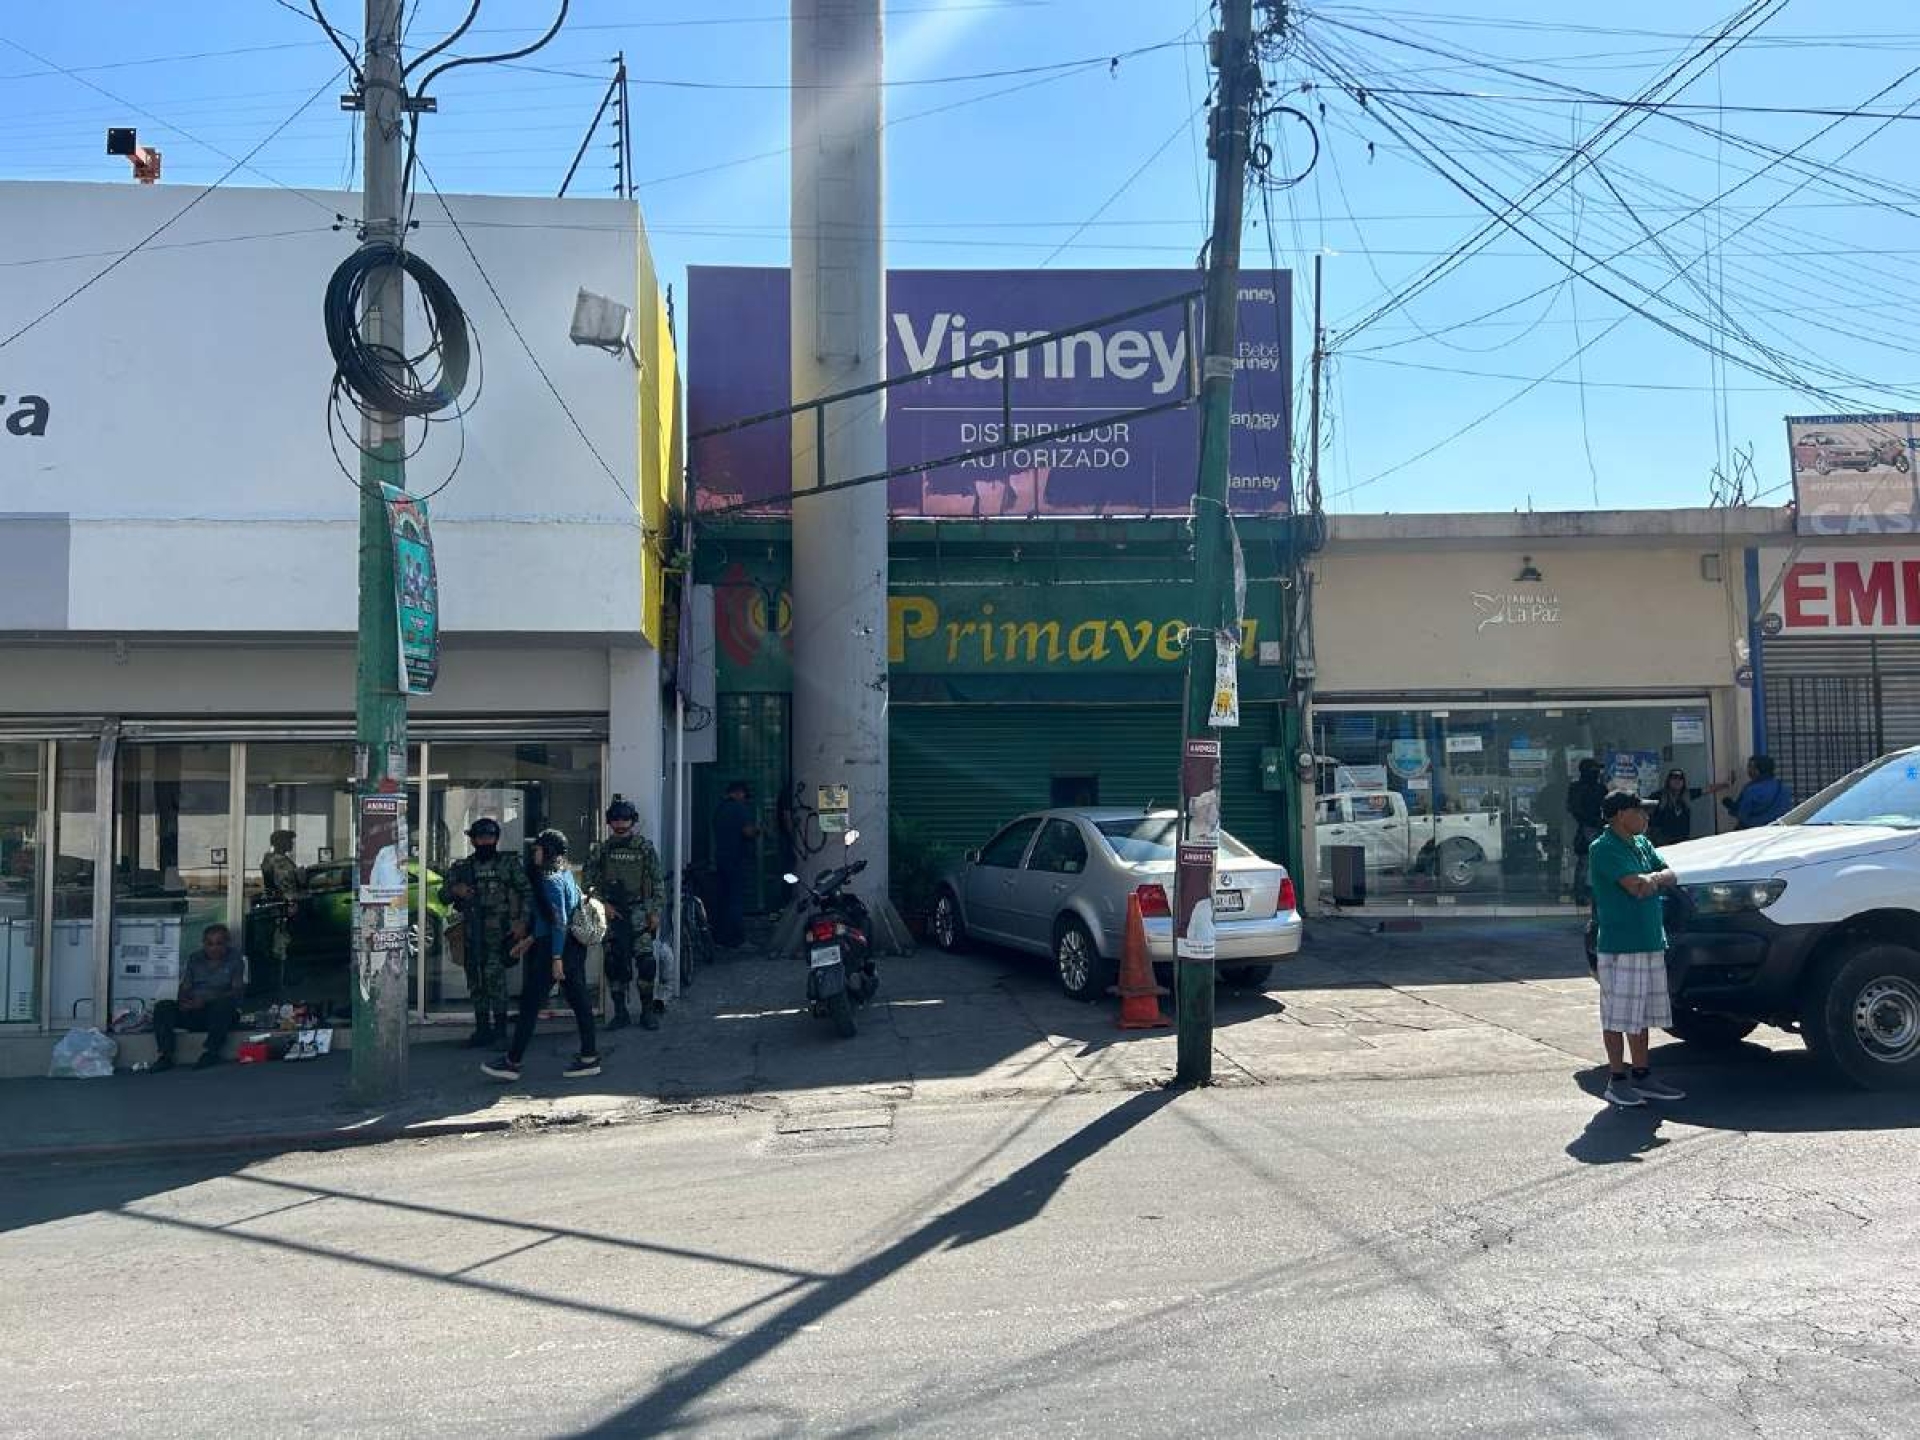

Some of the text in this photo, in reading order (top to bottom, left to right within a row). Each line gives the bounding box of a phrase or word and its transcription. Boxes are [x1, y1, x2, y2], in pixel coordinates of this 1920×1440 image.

[893, 313, 1186, 394] Vianney
[1239, 341, 1279, 357] Bebé
[961, 449, 1129, 468] AUTORIZADO
